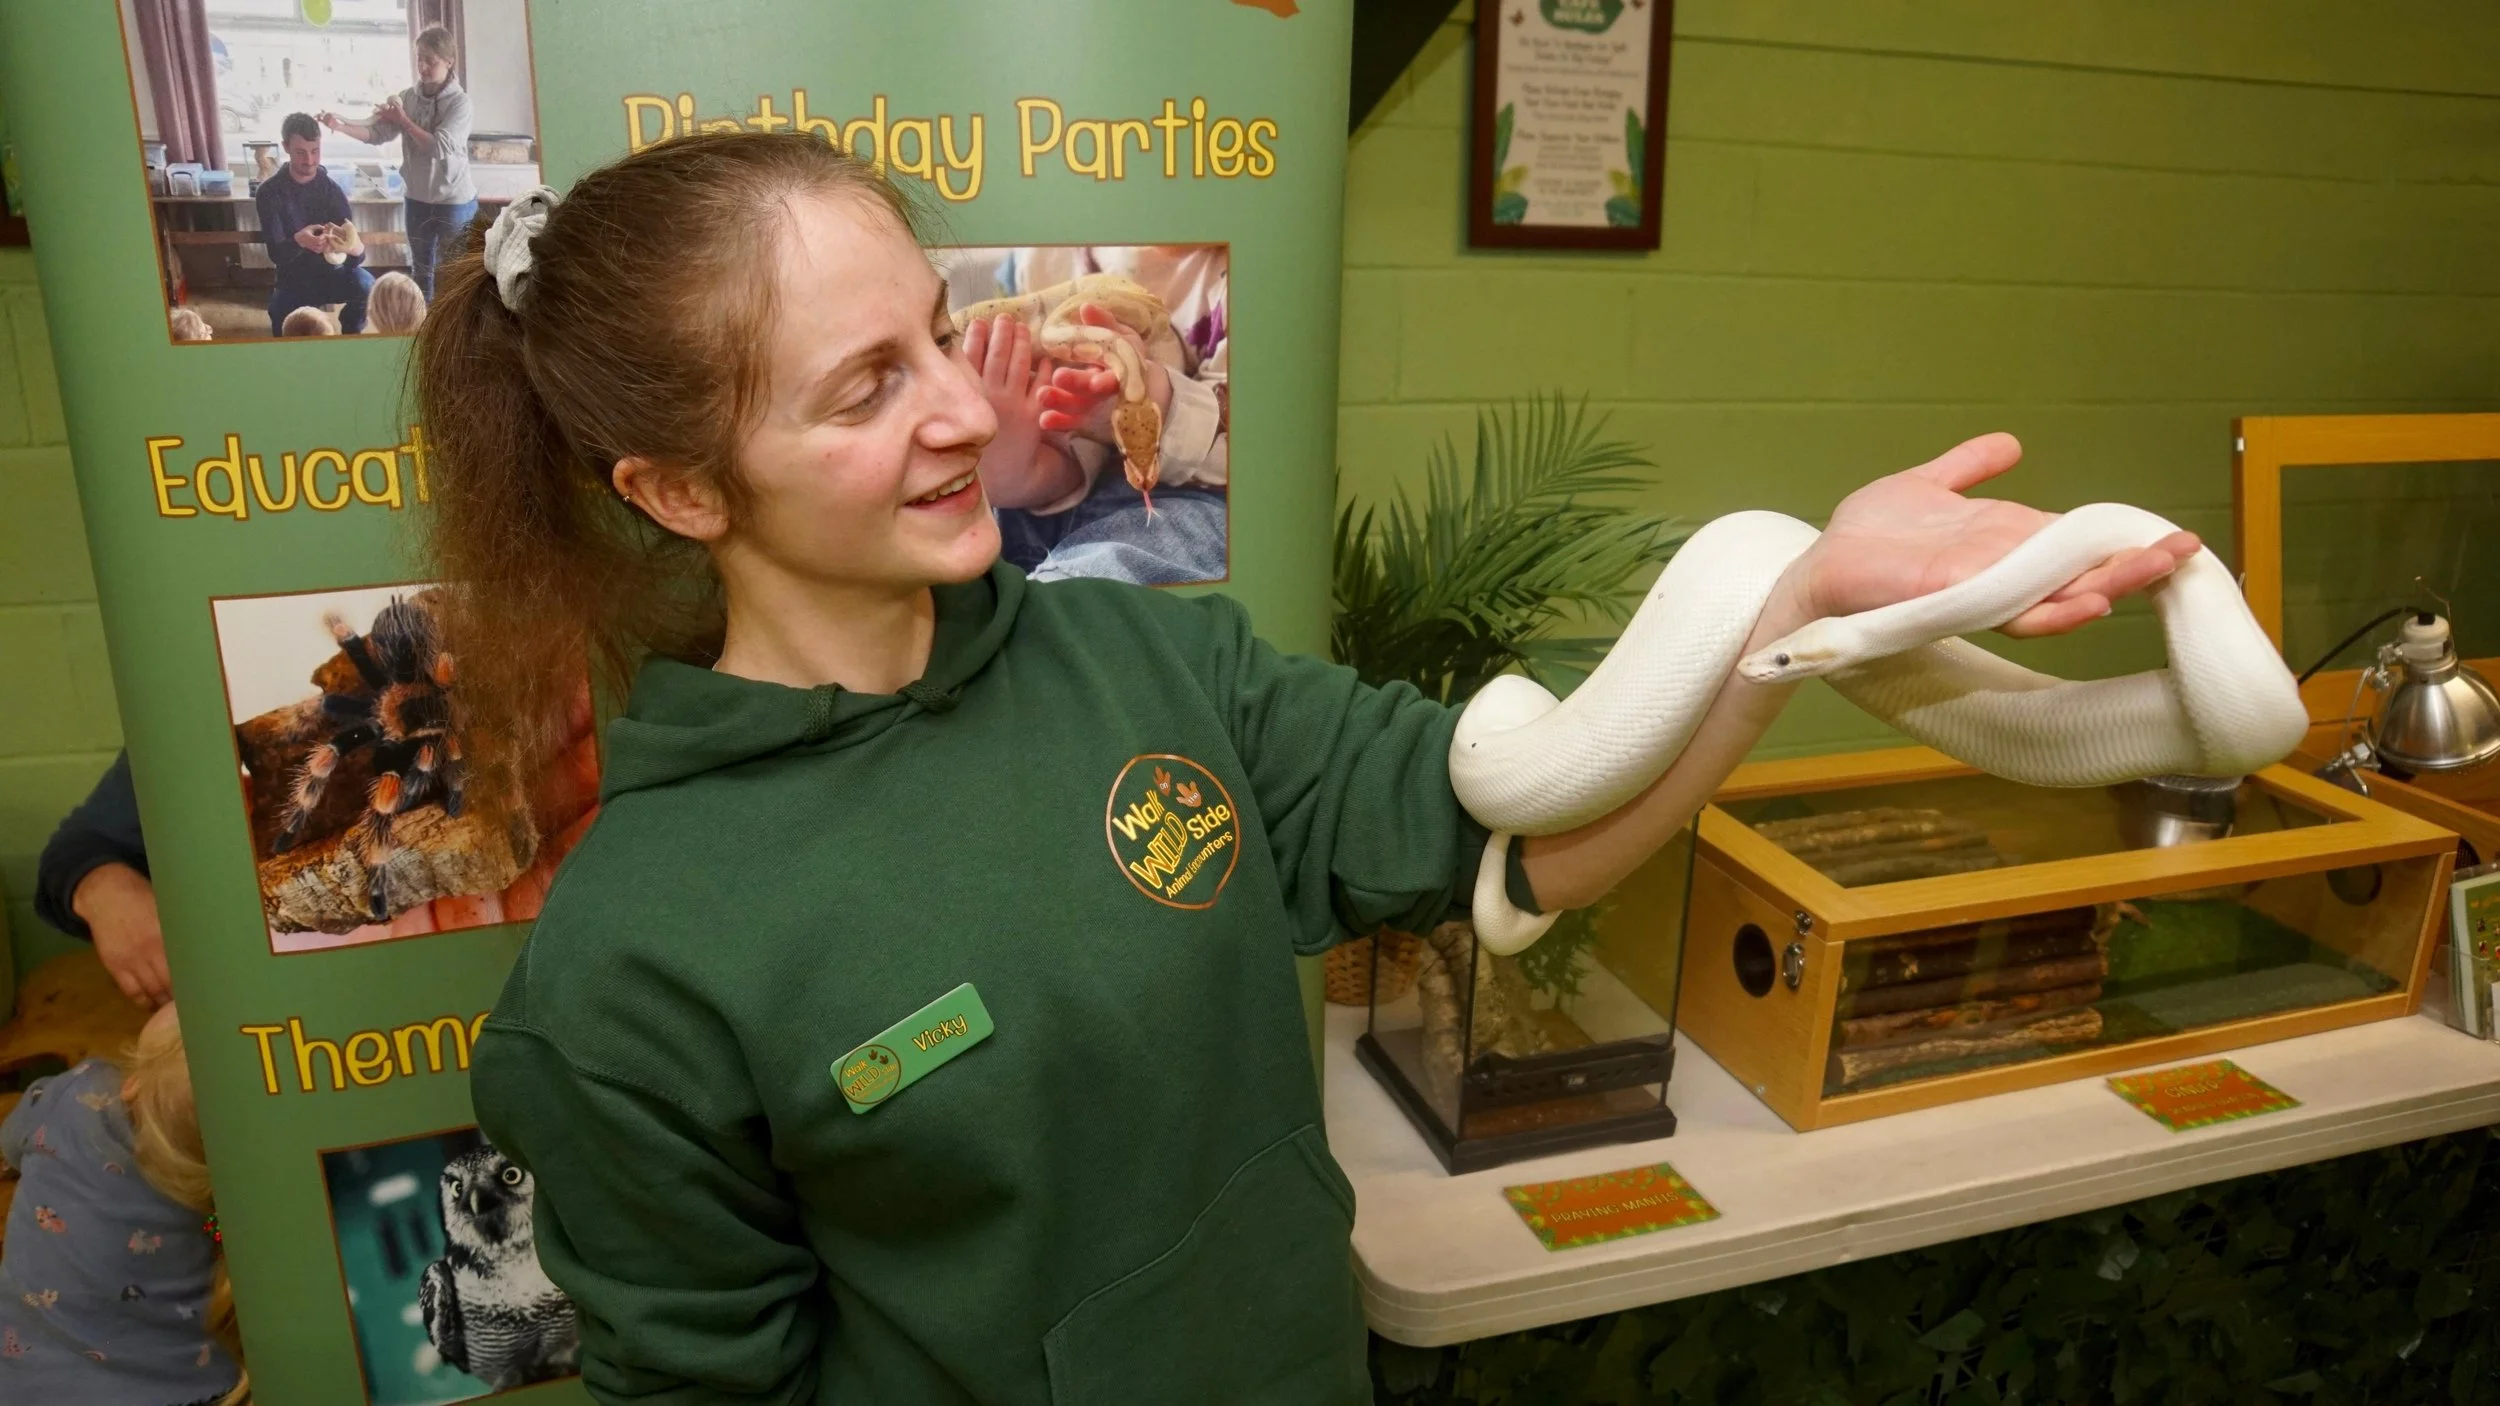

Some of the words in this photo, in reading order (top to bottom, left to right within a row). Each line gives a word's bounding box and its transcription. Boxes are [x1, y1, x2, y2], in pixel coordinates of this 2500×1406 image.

[1014, 97, 1278, 179] Parties
[1112, 790, 1165, 841] Walk
[1130, 812, 1188, 888] WILD
[1186, 804, 1231, 840] Side
[1165, 867, 1194, 899] Animal
[1188, 831, 1233, 874] Encounters
[239, 1010, 492, 1095] Them
[912, 1014, 968, 1052] Vicky
[845, 1059, 868, 1078] Walk
[845, 1066, 880, 1097] WILD
[1550, 1203, 1620, 1223] PRAYING
[1623, 1191, 1679, 1212] MANTIS
